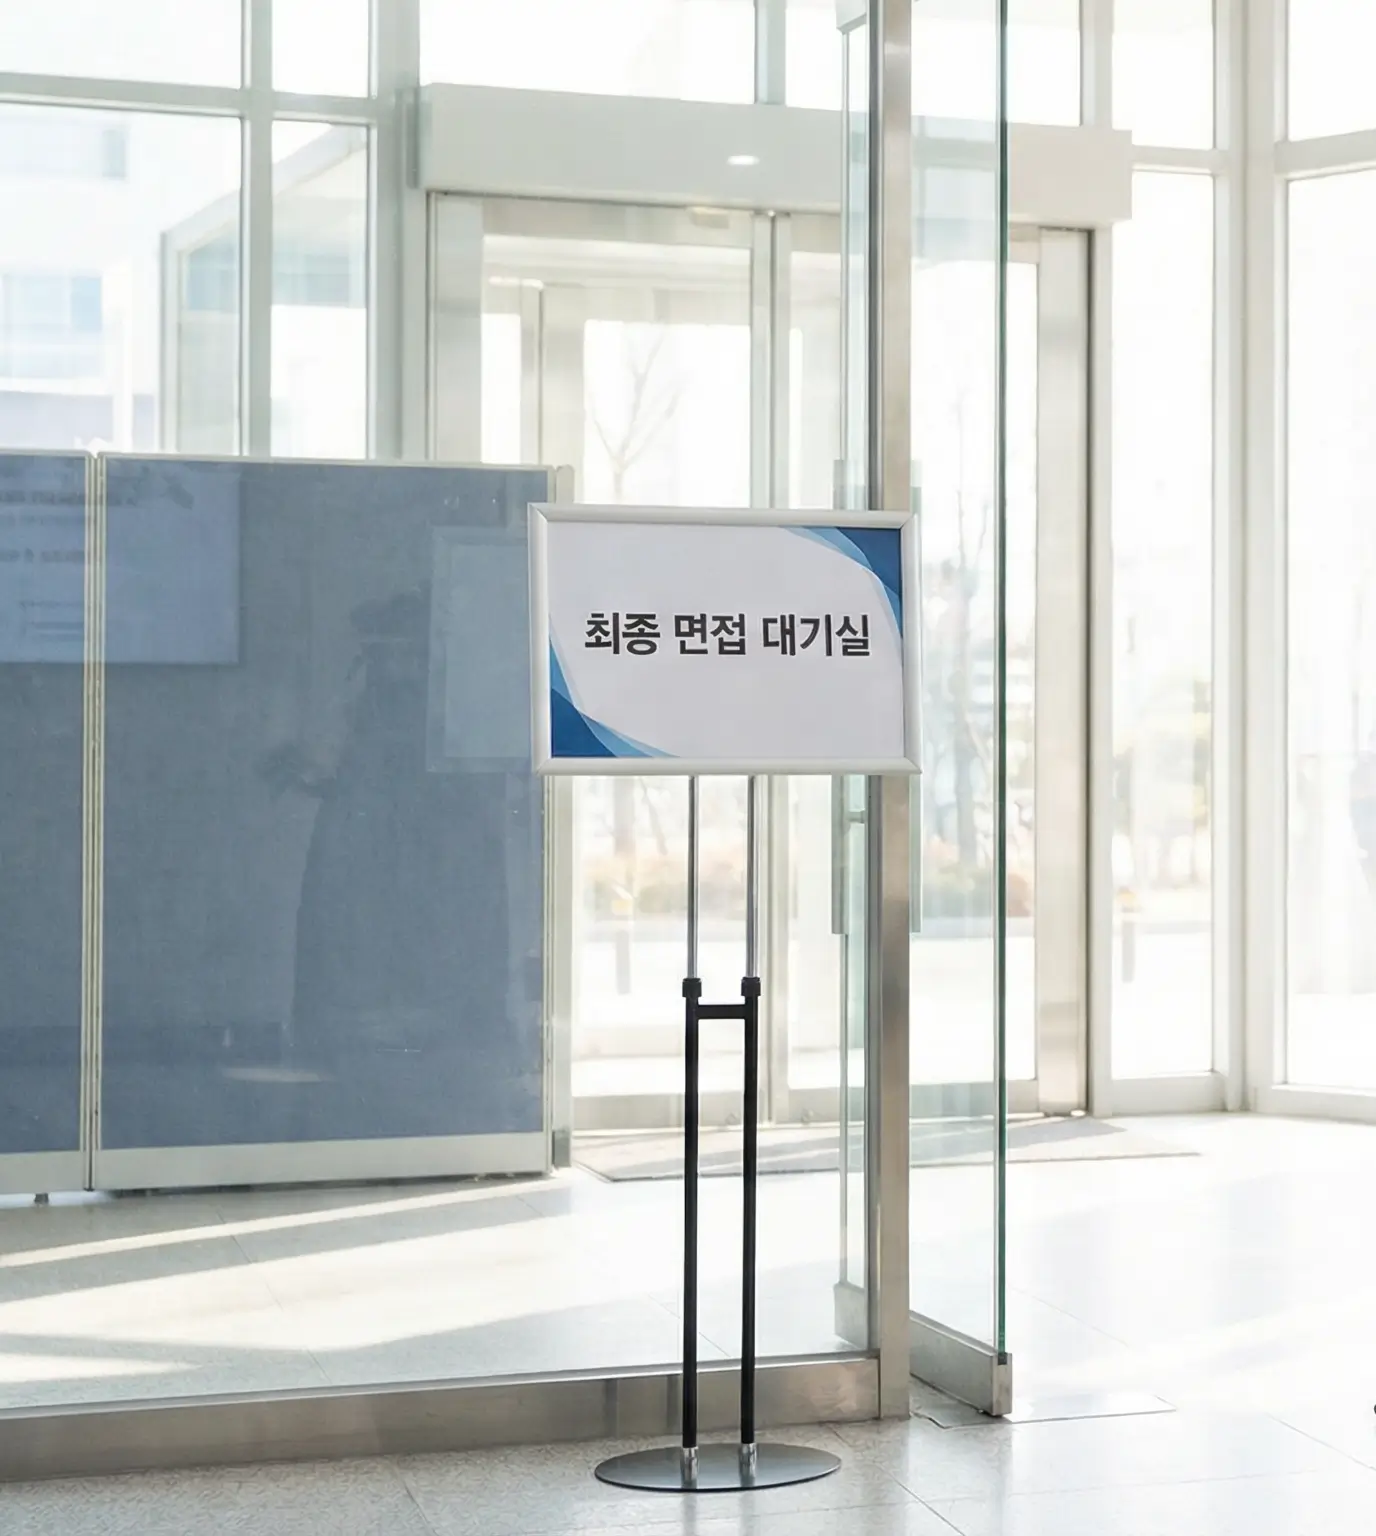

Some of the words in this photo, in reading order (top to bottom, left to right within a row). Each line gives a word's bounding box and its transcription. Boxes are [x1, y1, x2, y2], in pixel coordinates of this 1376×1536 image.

[584, 612, 661, 656] 최종
[674, 612, 746, 656] 면접
[762, 613, 870, 657] 대기실
